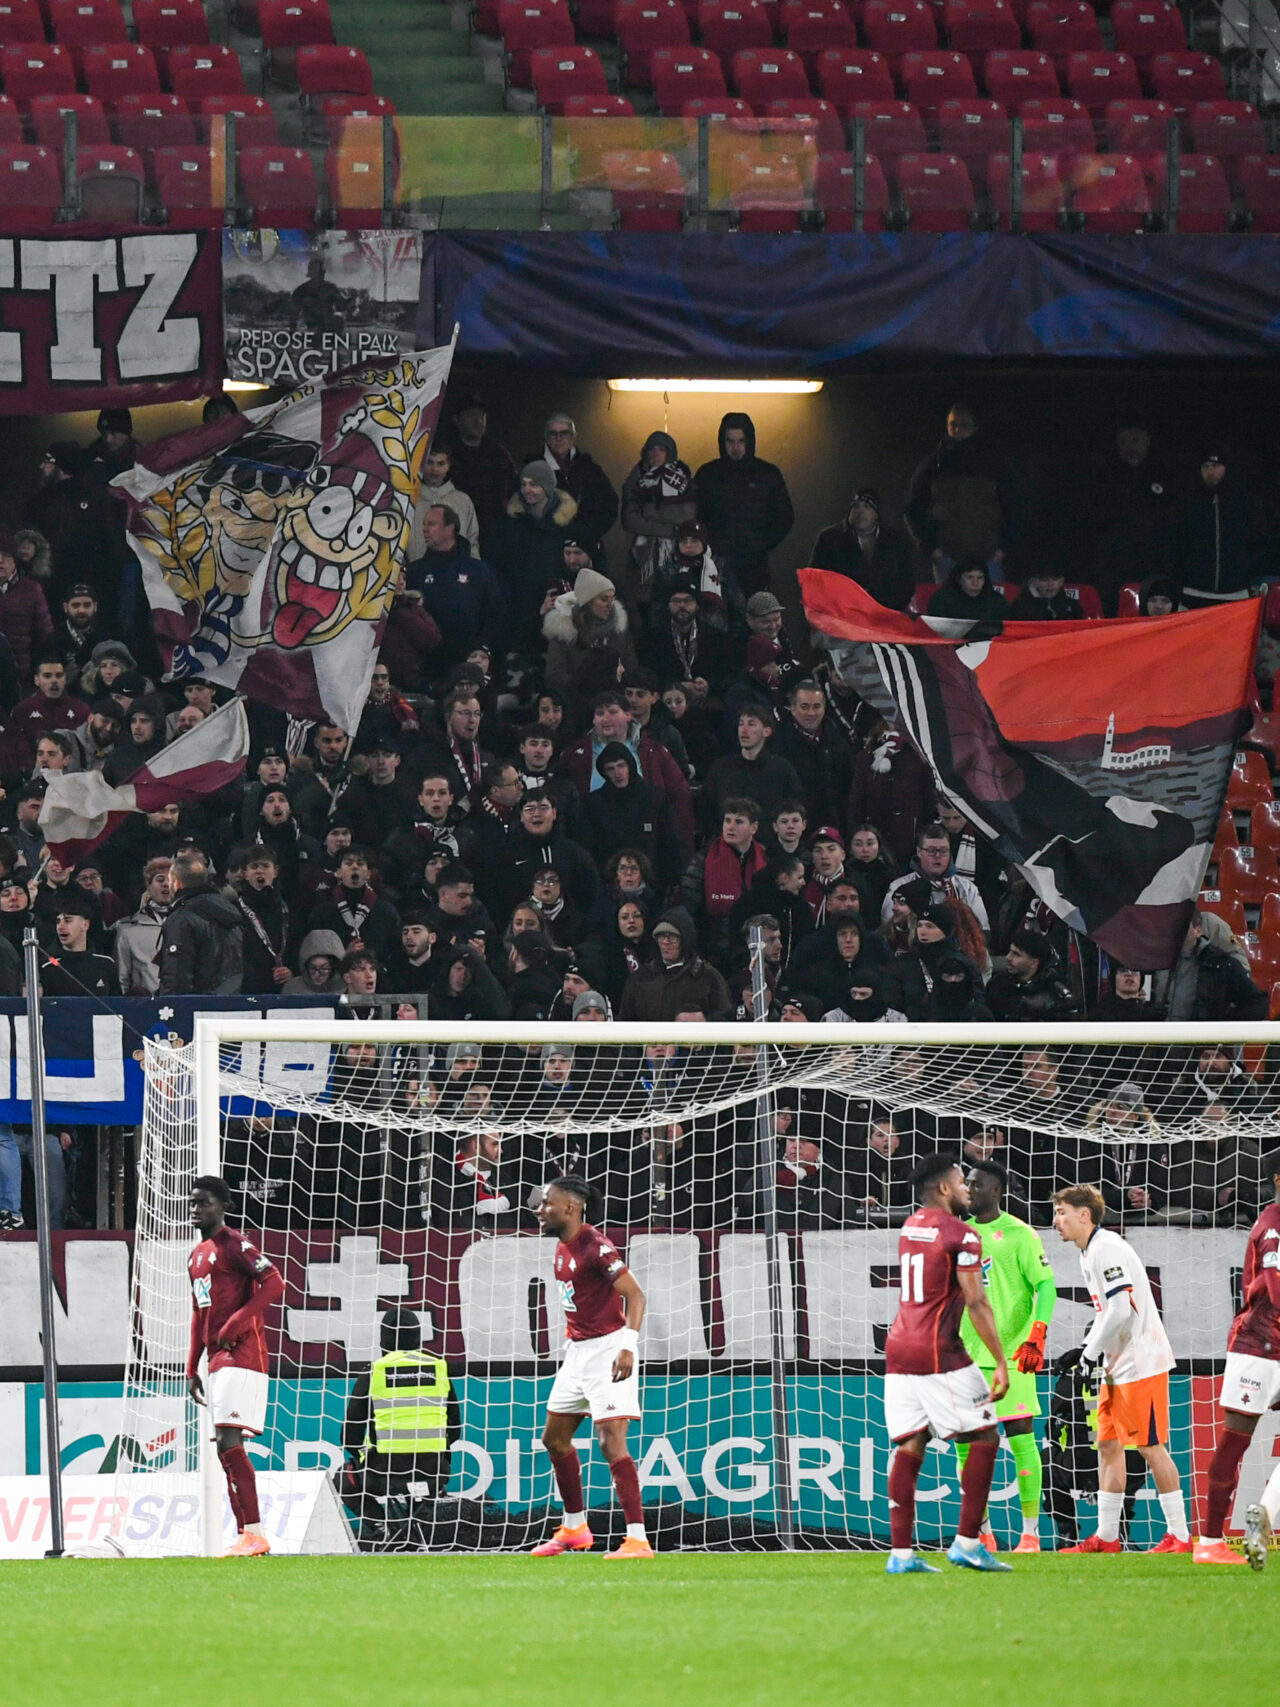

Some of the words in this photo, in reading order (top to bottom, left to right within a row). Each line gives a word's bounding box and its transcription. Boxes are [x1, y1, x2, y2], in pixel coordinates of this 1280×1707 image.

[240, 329, 315, 349] REPOSE
[322, 333, 350, 350] EN
[358, 333, 399, 351] PAIX
[900, 1252, 925, 1303] 11
